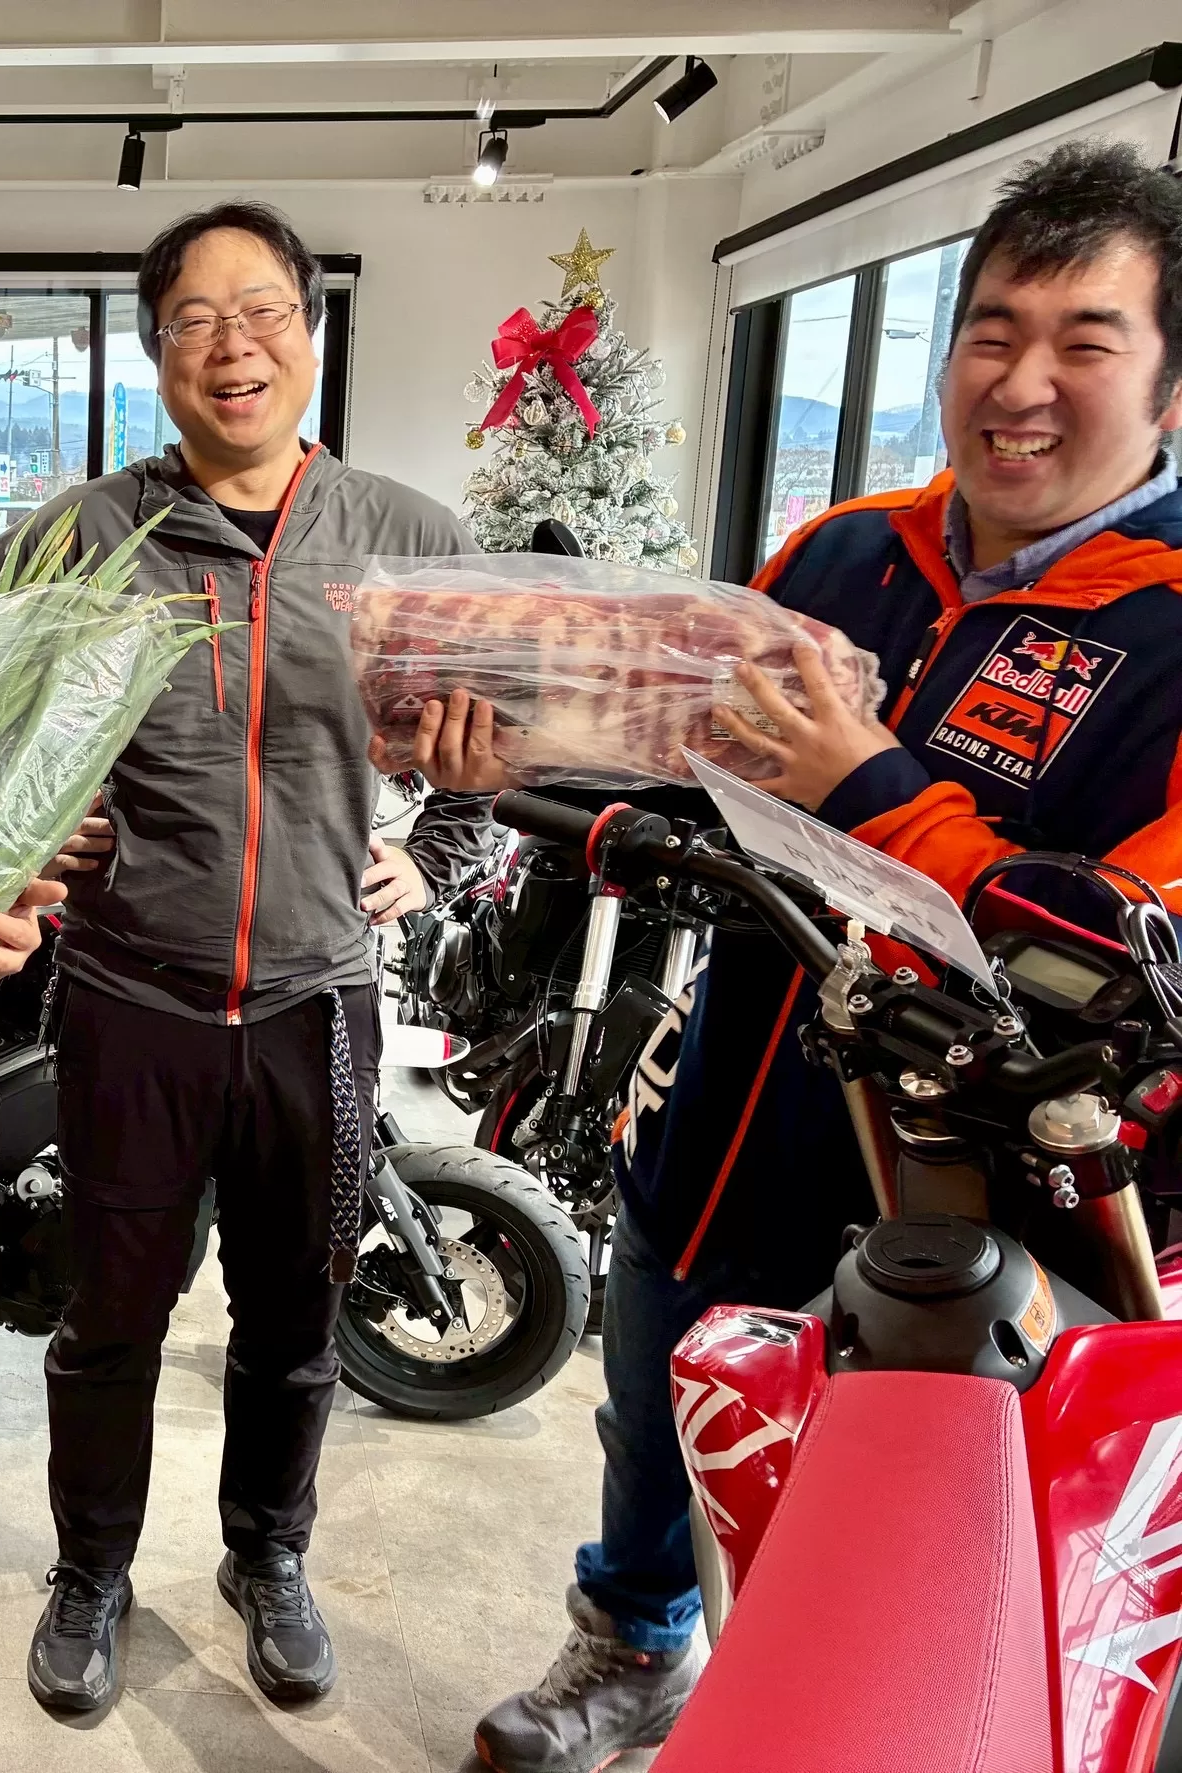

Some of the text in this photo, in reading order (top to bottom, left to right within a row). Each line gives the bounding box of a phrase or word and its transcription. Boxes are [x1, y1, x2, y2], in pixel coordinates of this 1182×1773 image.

[323, 582, 359, 590] MOUNT
[326, 589, 350, 602] HARD
[936, 727, 991, 759] RACING
[378, 1195, 398, 1221] ABS
